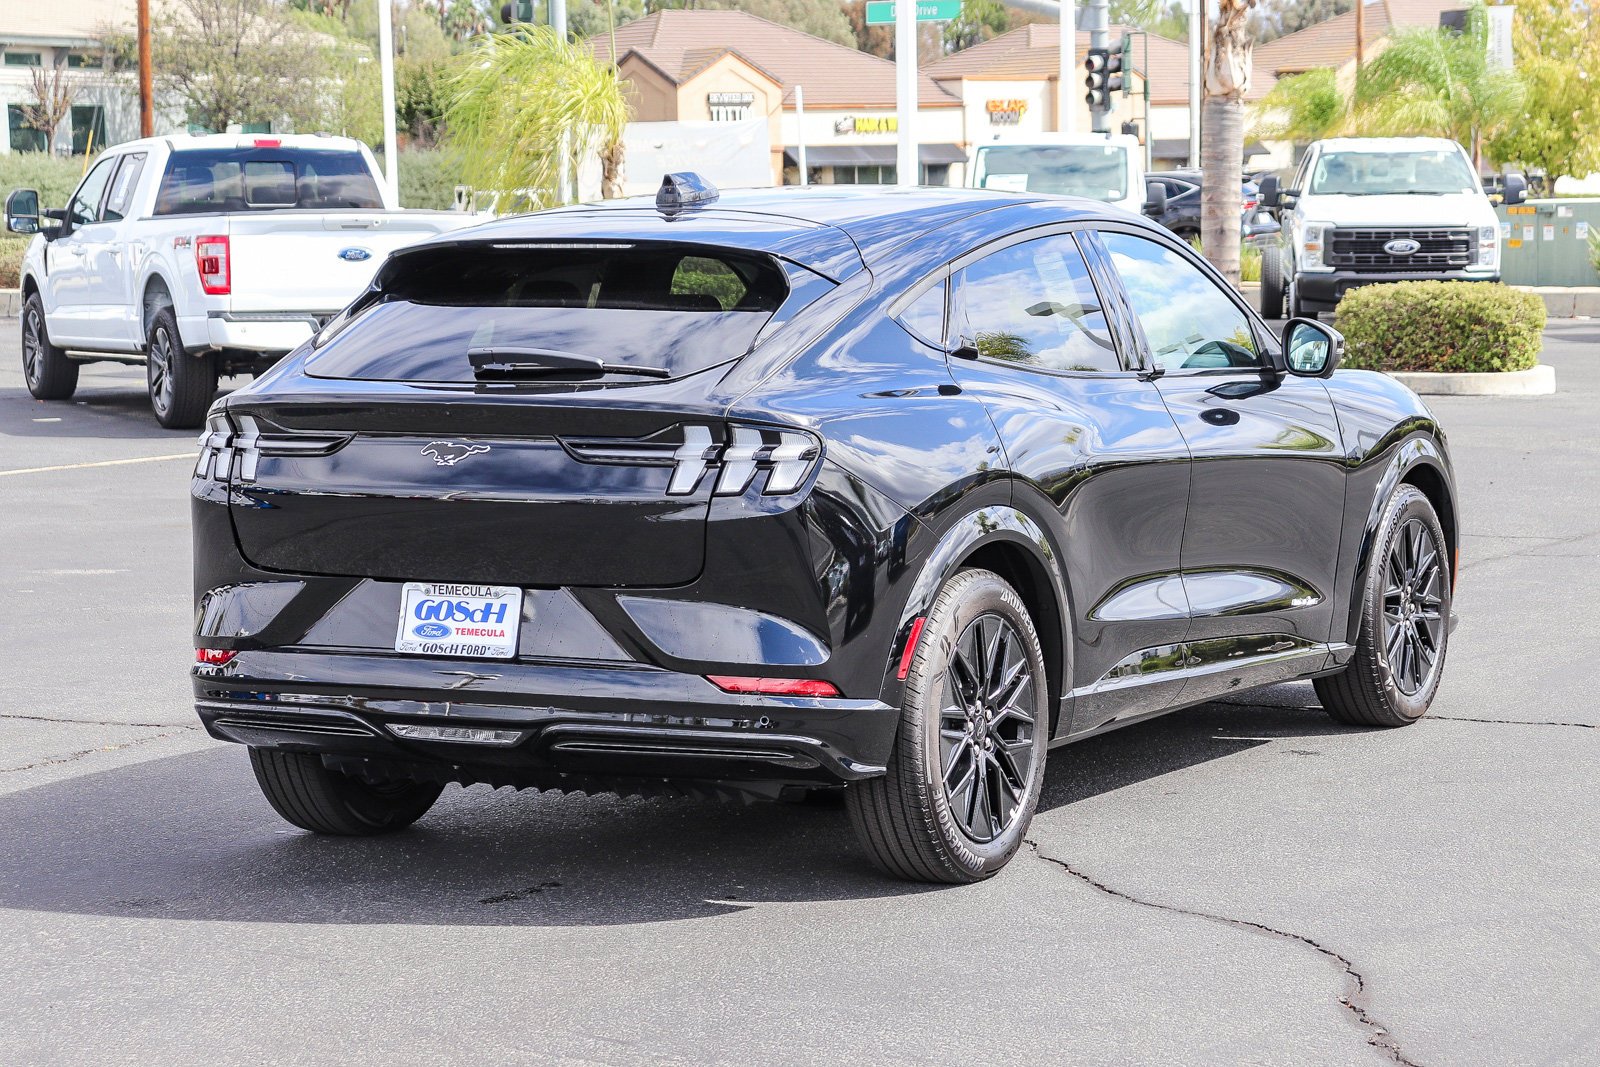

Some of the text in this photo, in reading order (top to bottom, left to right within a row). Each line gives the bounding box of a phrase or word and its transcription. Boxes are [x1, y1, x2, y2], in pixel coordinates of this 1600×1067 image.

[431, 584, 493, 598] TEMECULA
[420, 625, 443, 637] Ford
[455, 627, 506, 638] TEMECULA
[1000, 587, 1045, 672] BRIDGESTONE
[932, 788, 986, 872] BRIDGESTONE
